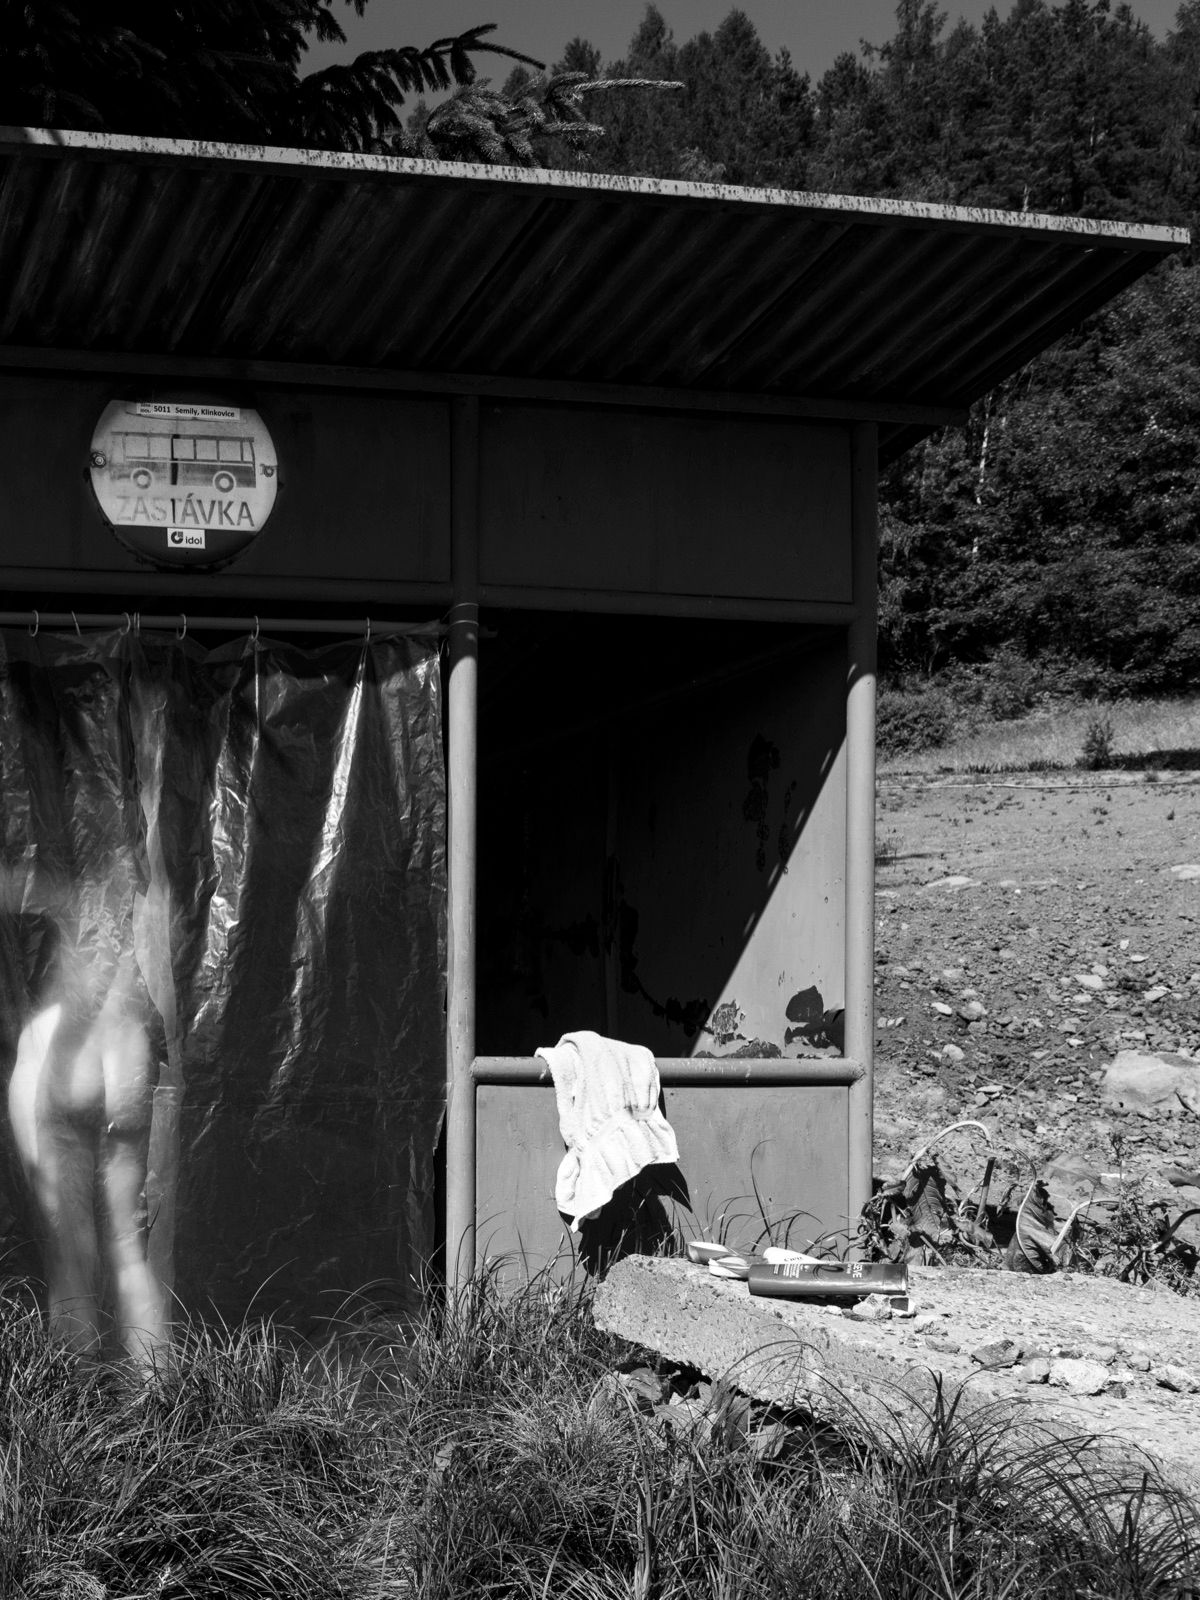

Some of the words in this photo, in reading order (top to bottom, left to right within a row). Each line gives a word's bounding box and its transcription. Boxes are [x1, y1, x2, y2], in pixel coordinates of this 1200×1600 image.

[153, 405, 171, 413] 5011
[175, 407, 200, 416] Semily,
[200, 408, 235, 418] Klinkovice
[116, 493, 256, 527] ZASTÁVKA
[185, 535, 203, 545] idol
